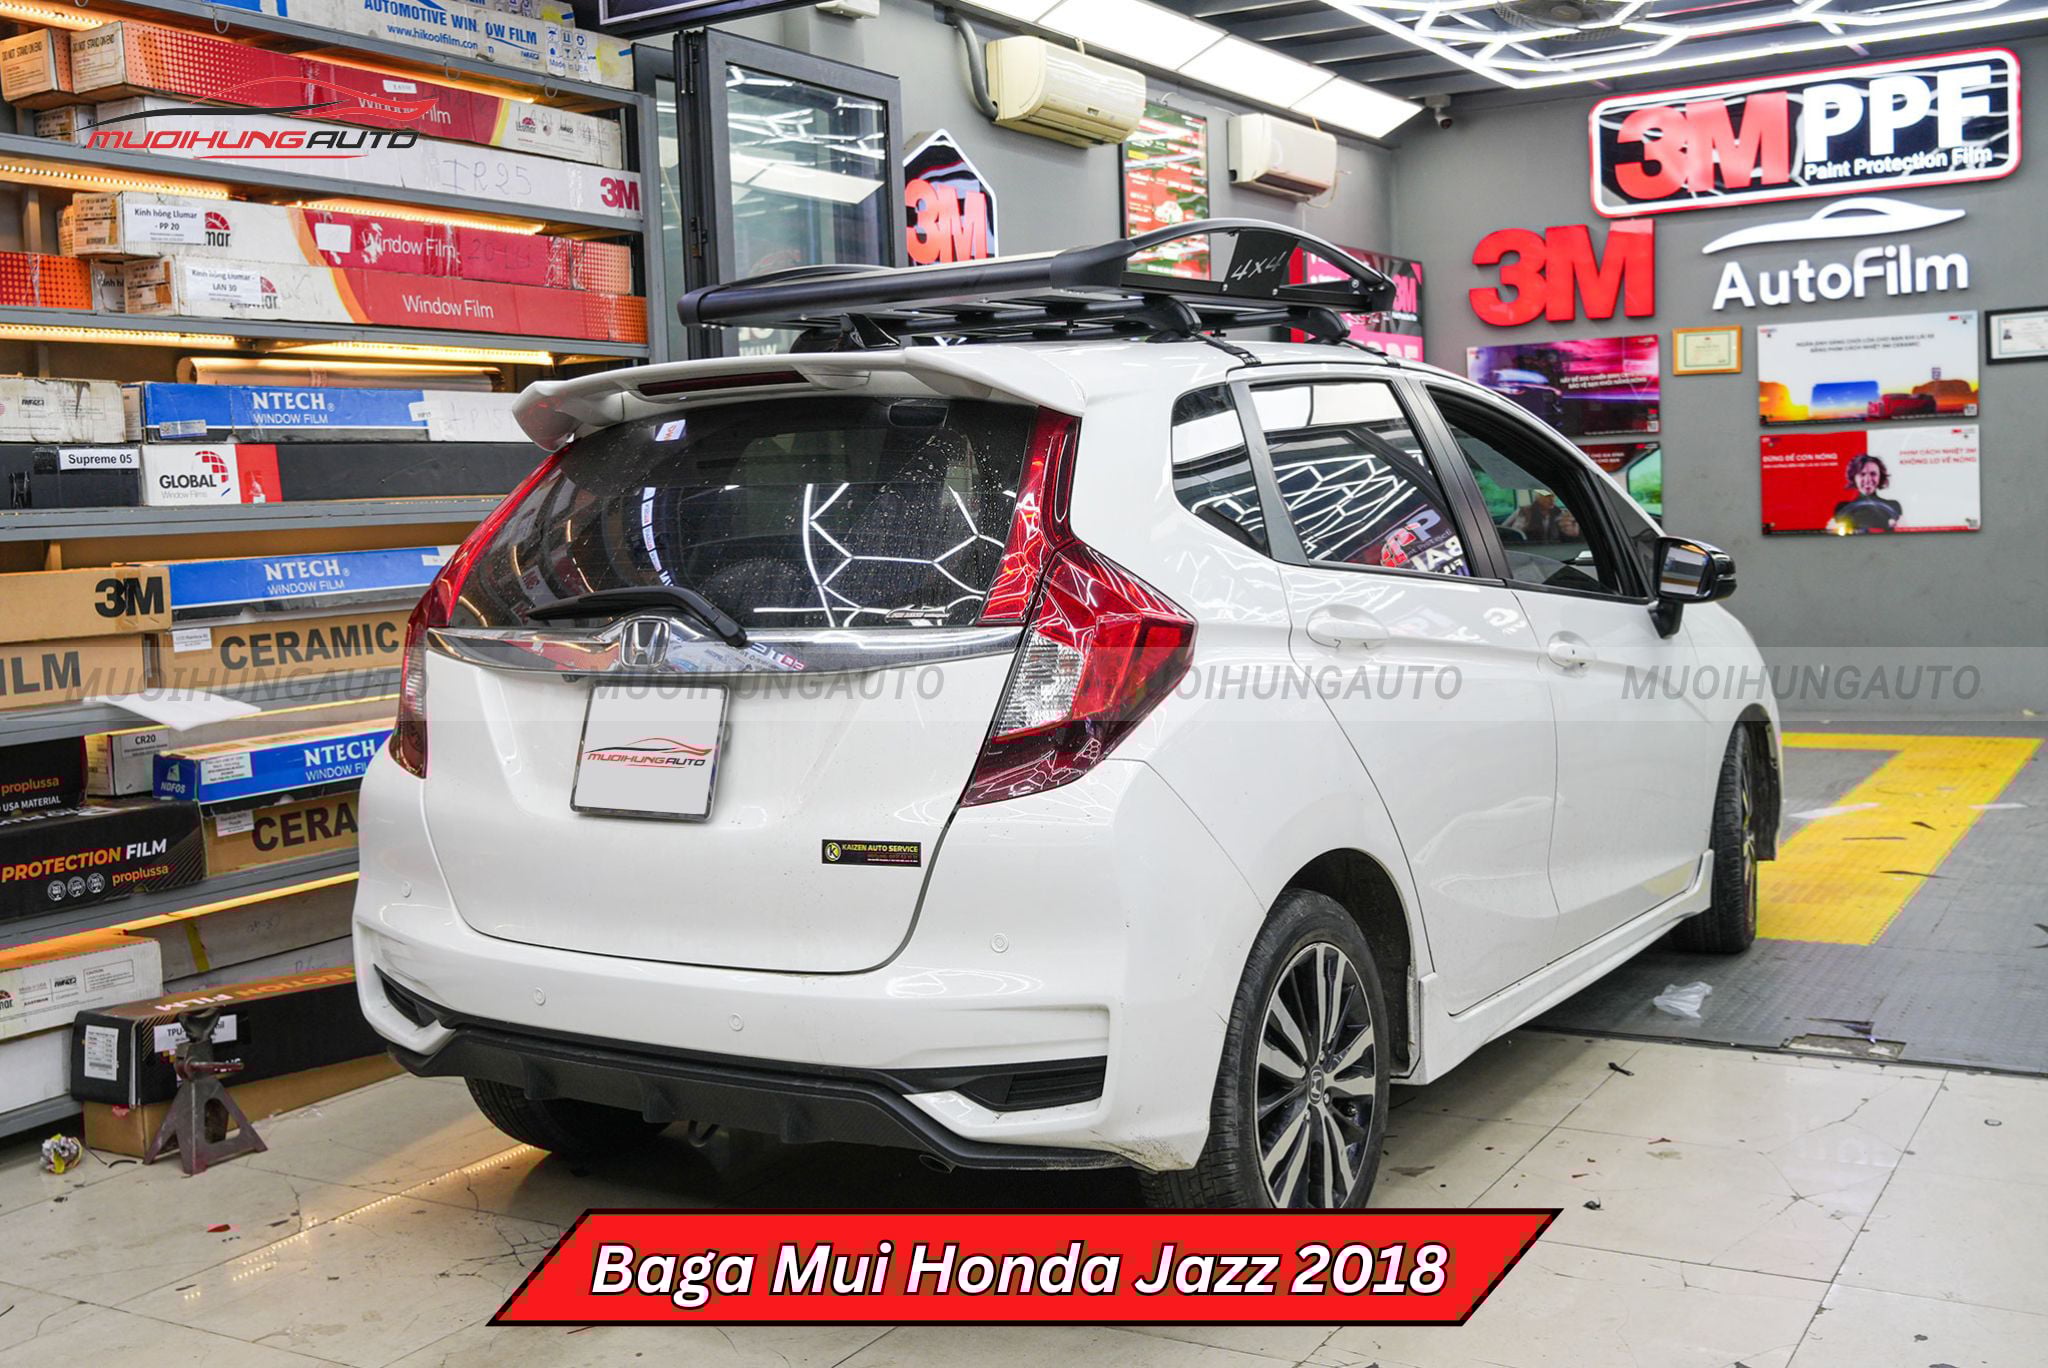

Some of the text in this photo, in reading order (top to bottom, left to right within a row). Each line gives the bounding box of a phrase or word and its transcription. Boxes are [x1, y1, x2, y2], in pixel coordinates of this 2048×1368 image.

[364, 0, 447, 26] AUTOMOTIVE
[509, 27, 537, 45] FILM
[1614, 65, 1993, 200] 3M PPF
[1804, 146, 1993, 181] Paint Protection Film
[600, 178, 641, 211] 3M
[171, 223, 180, 231] 20
[905, 178, 988, 265] 3M
[1467, 218, 1655, 326] 3M
[1712, 244, 1970, 311] AutoFilm
[402, 294, 494, 318] Window Film
[251, 391, 326, 410] NTECH
[253, 413, 329, 425] WINDOW FILM
[68, 453, 132, 466] Supreme 05
[159, 475, 217, 488] GLOBAL
[161, 490, 189, 499] Window
[264, 559, 341, 581] NTECH
[94, 576, 164, 619] 3M
[267, 579, 345, 596] WINDOW FILM
[220, 622, 400, 670] CERAMIC
[135, 734, 157, 746] CR20
[303, 739, 375, 767] NTECH
[305, 765, 353, 782] WINDOW
[1, 776, 60, 797] proplussa
[160, 781, 186, 794] NDFOS
[2, 795, 62, 813] USA MATERIAL
[867, 844, 888, 852] AUTO
[888, 845, 919, 853] SERVICE
[1, 838, 167, 883] PROTECTION FILM
[111, 864, 169, 887] proplussa
[155, 993, 234, 1011] FILM
